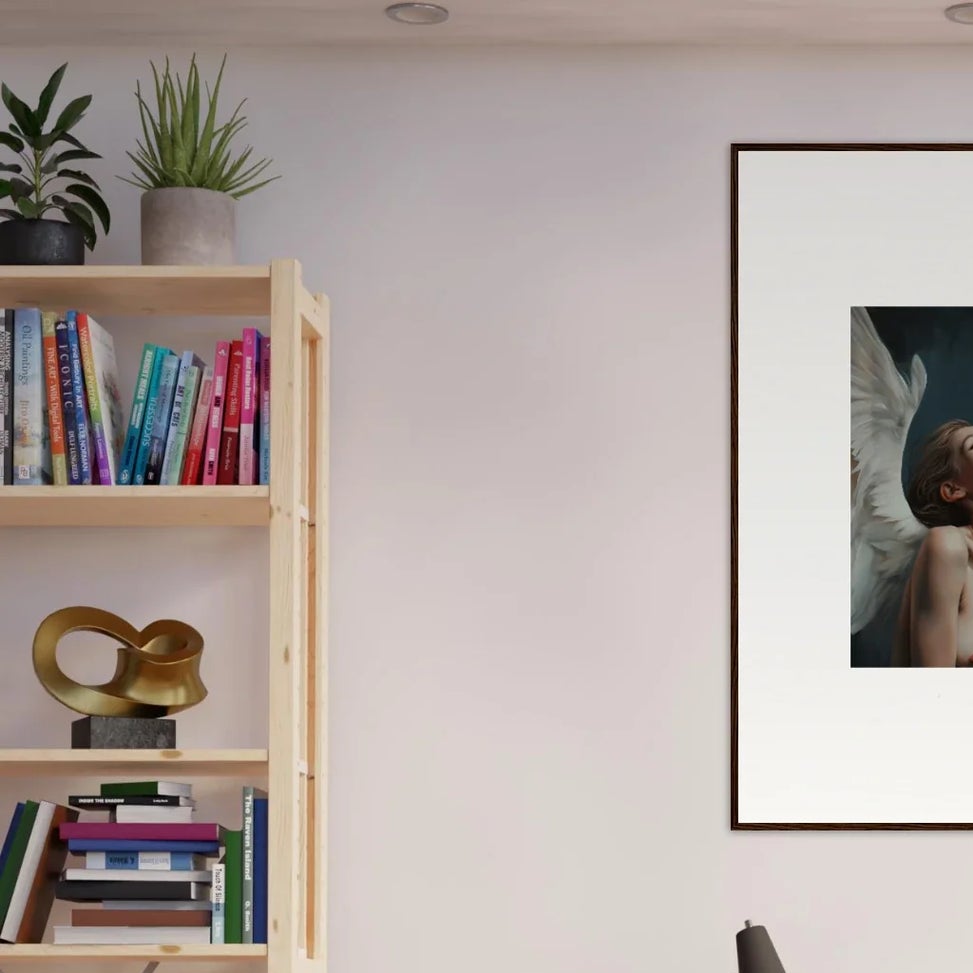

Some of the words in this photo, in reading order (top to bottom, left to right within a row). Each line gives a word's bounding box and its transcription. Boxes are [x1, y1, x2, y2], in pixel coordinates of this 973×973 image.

[22, 325, 32, 340] Oil
[18, 342, 32, 385] Paintings
[47, 347, 55, 364] FINE
[49, 365, 57, 379] ART
[59, 344, 74, 408] ICONIC
[72, 359, 82, 384] Beauty
[80, 327, 93, 373] Watercolor
[87, 374, 97, 411] Portraits
[229, 363, 241, 398] Parenting
[176, 384, 185, 397] ART
[49, 402, 61, 425] Digital
[229, 398, 238, 416] Skills
[171, 412, 181, 427] CATS
[53, 425, 63, 442] Tools
[79, 440, 89, 472] NORMAN
[244, 794, 252, 814] The
[244, 816, 252, 848] Raven
[244, 849, 252, 880] Island
